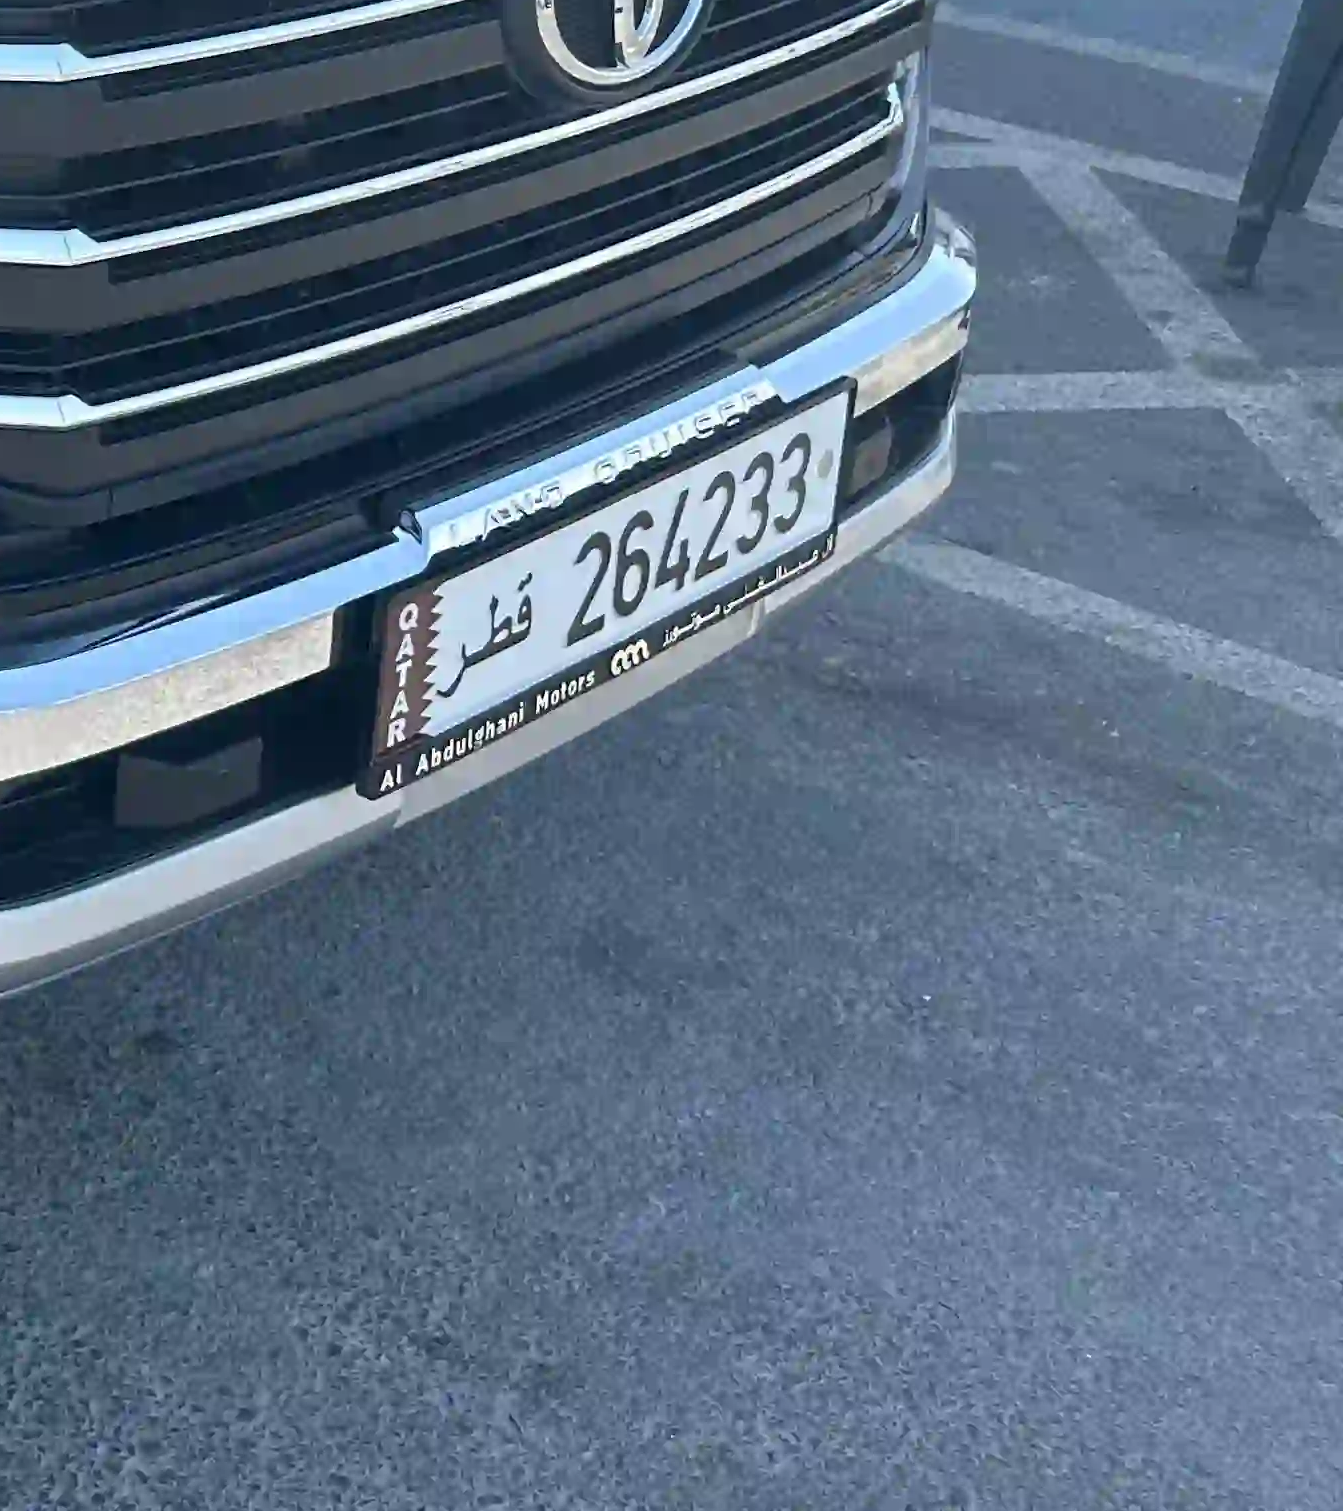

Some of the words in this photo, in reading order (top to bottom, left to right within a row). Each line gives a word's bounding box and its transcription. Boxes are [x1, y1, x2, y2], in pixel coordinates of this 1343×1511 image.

[591, 389, 765, 484] CRUISER
[564, 432, 812, 648] 264233
[386, 602, 420, 748] QATAR
[436, 571, 533, 699] قطر
[379, 763, 403, 792] Al
[415, 701, 525, 777] Abdulghani
[534, 669, 596, 714] Motors
